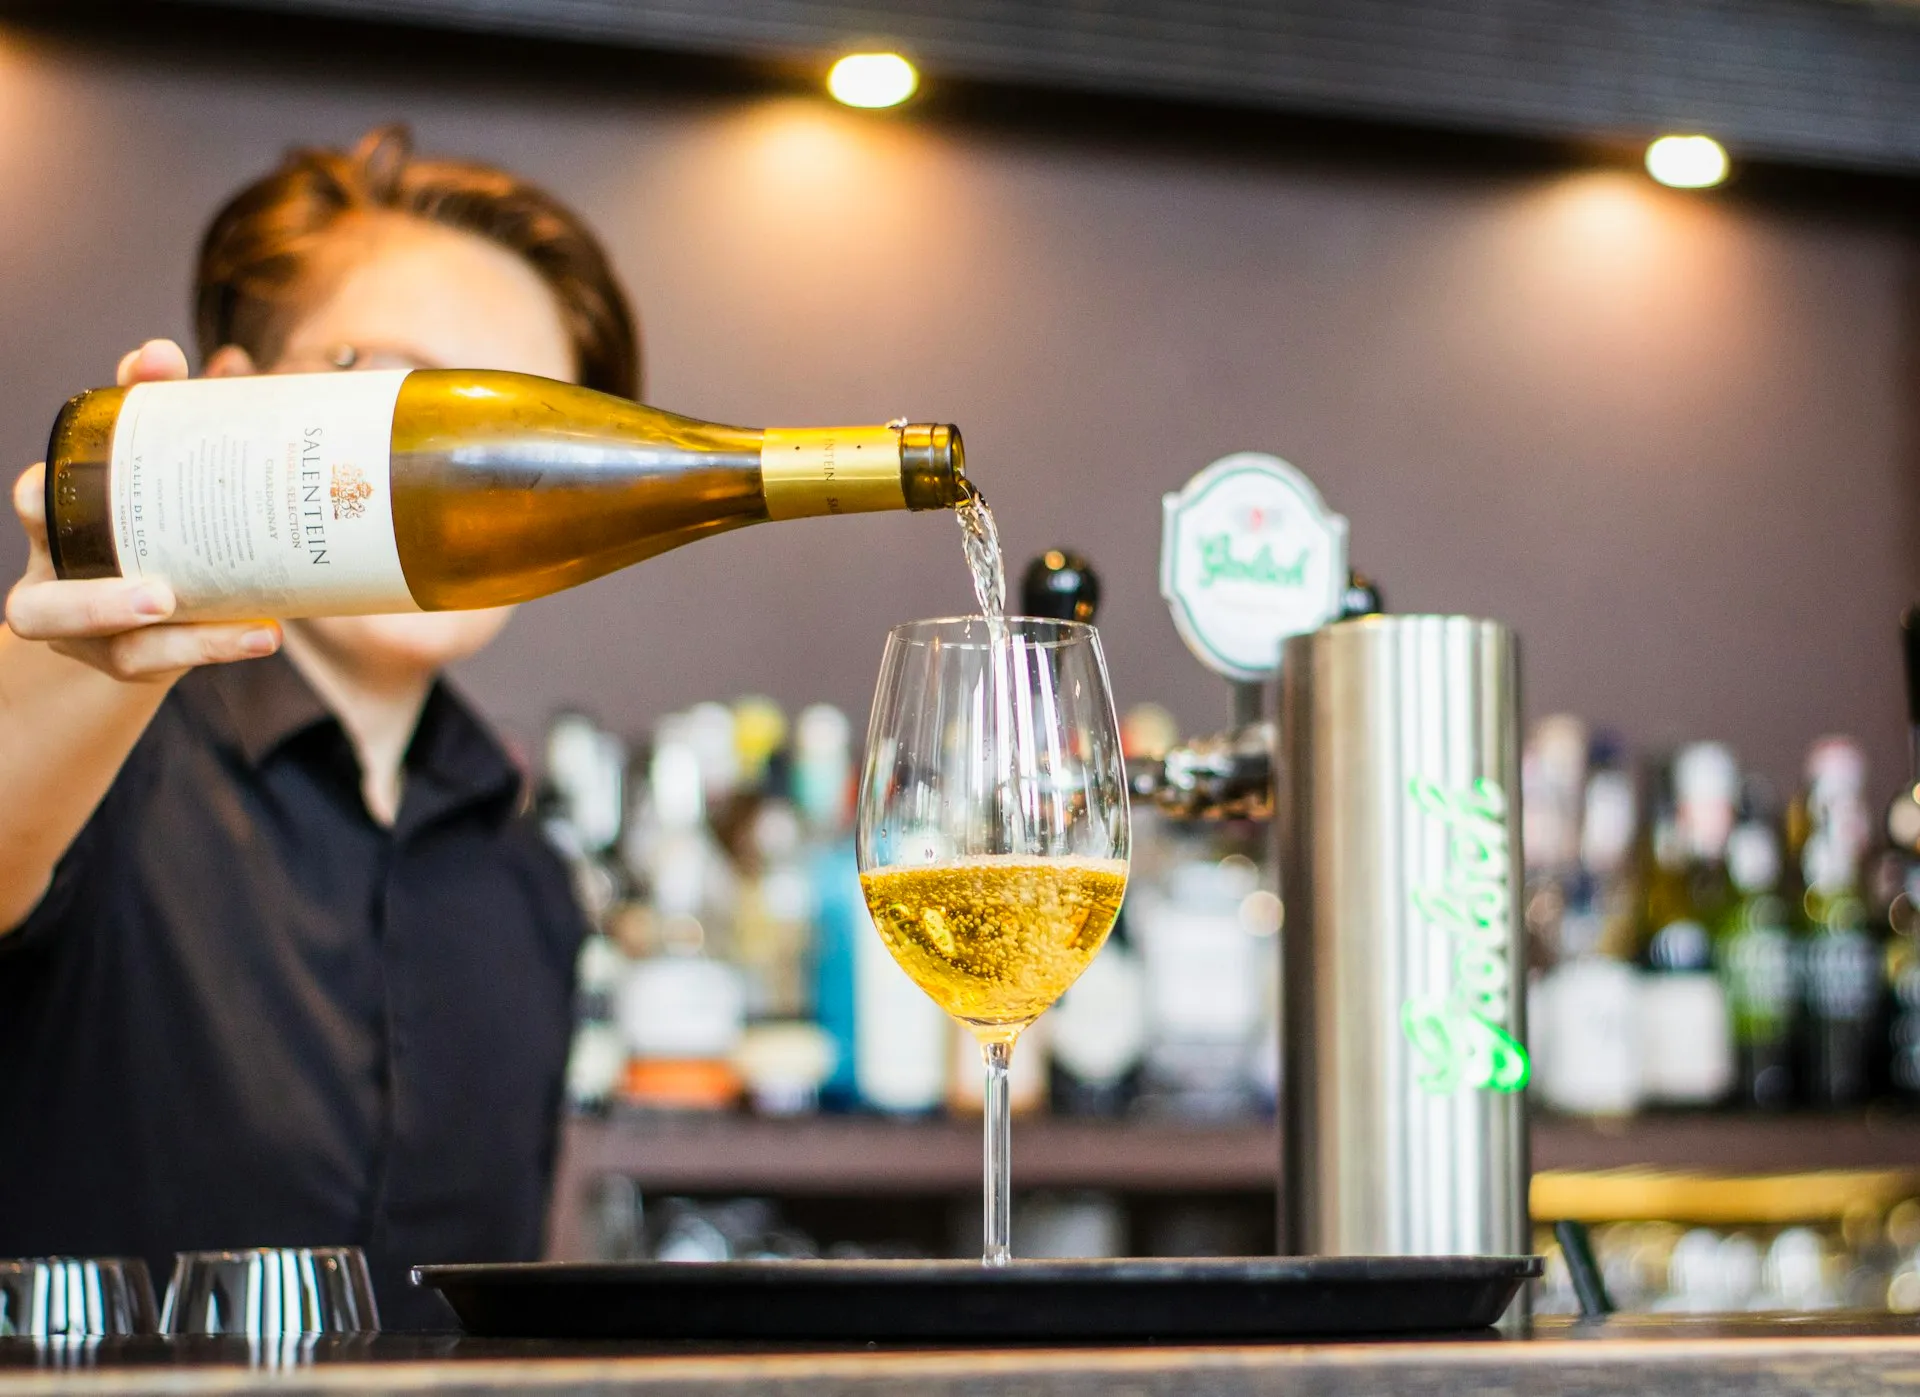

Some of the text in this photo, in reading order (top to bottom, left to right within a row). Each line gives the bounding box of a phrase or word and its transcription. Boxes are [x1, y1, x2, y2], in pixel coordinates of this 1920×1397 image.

[119, 504, 129, 549] ARGENTINA
[133, 456, 148, 557] VALLE DE UCO
[265, 458, 279, 540] CHARDONNAY
[285, 442, 302, 549] BARREL SELECTION
[302, 427, 330, 566] SALENTEIN
[1401, 775, 1531, 1096] Grolsch
